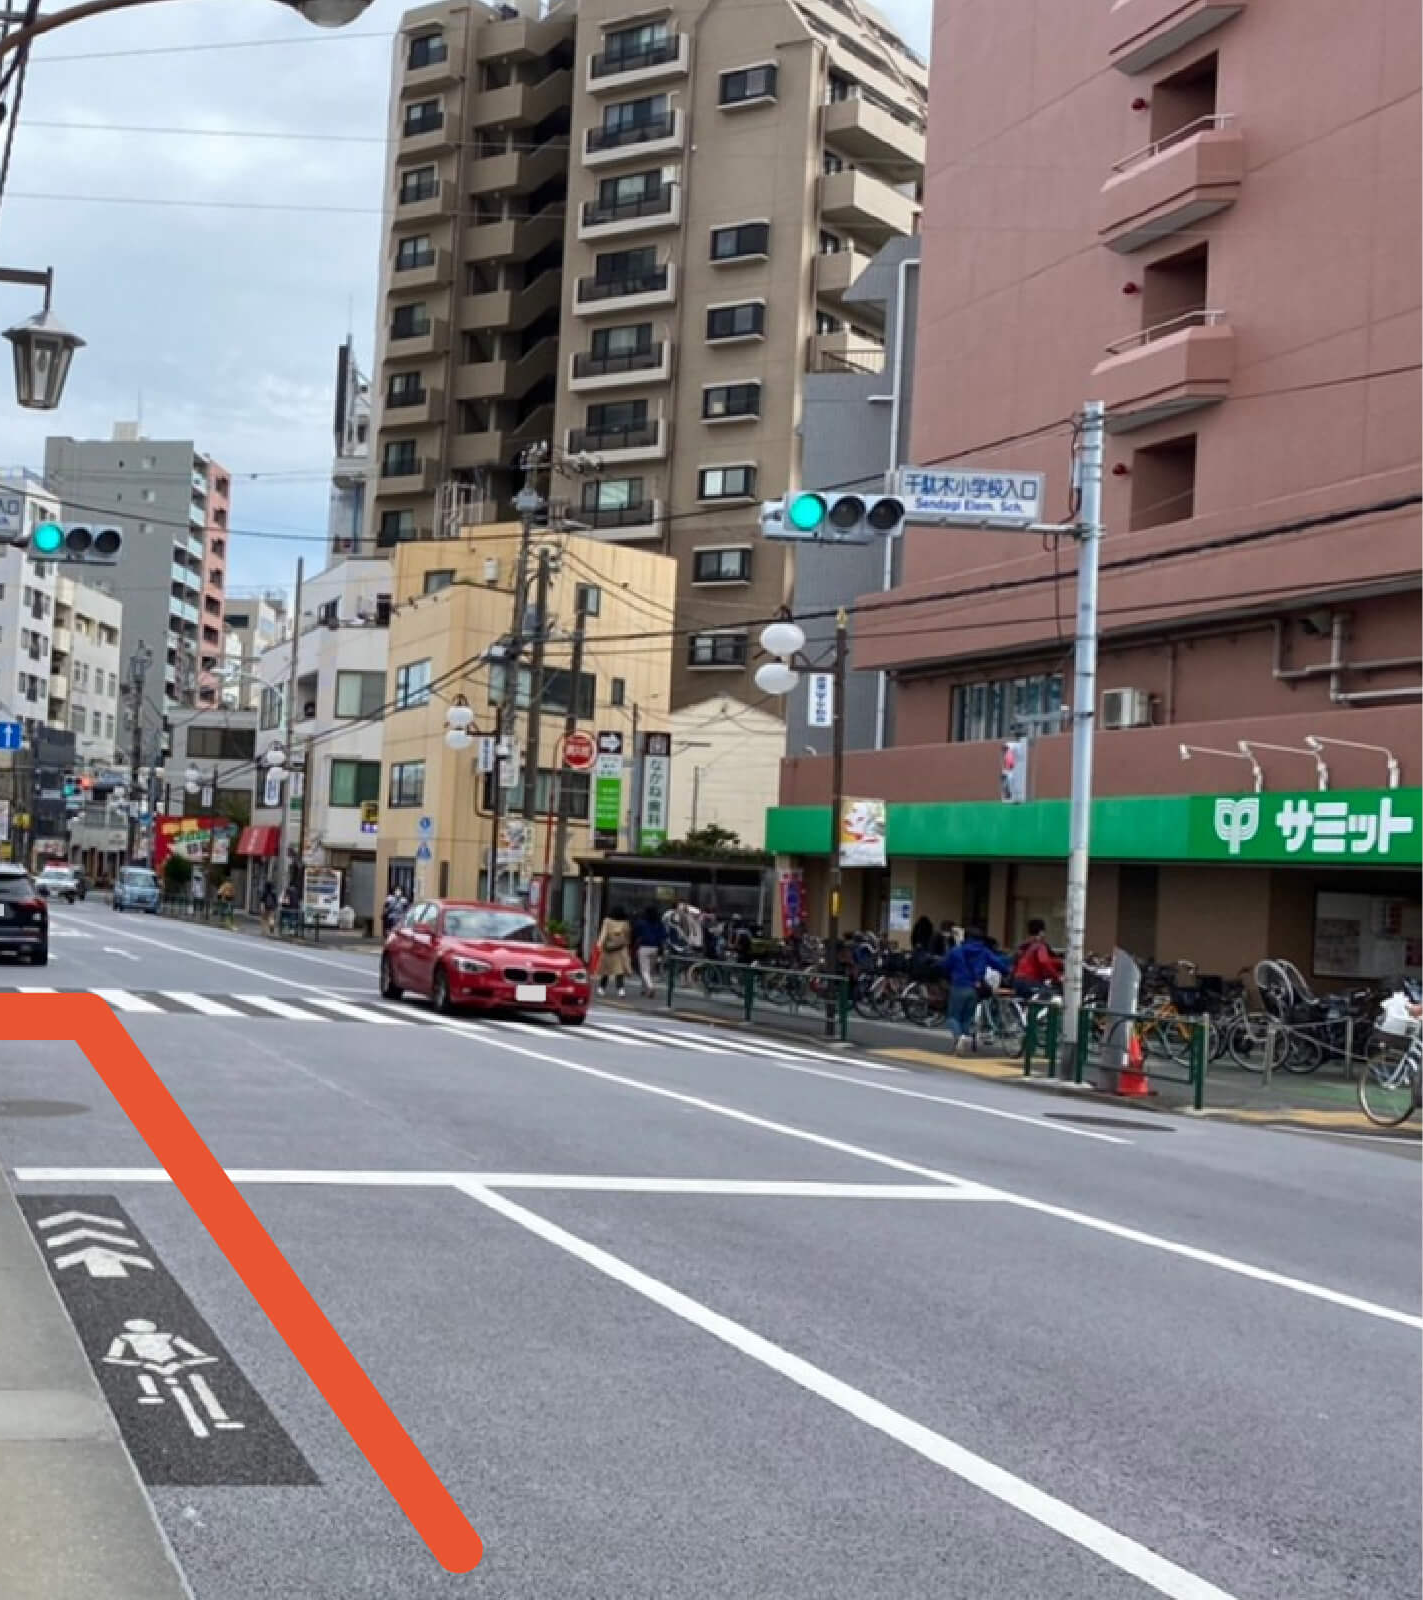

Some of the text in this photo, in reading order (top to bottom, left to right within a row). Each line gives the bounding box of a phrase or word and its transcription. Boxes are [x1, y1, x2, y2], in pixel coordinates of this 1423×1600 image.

[906, 474, 1036, 500] 千駄木小学校入口
[915, 498, 1023, 512] Sendagi Elem. Sch.
[1276, 797, 1413, 853] サミット
